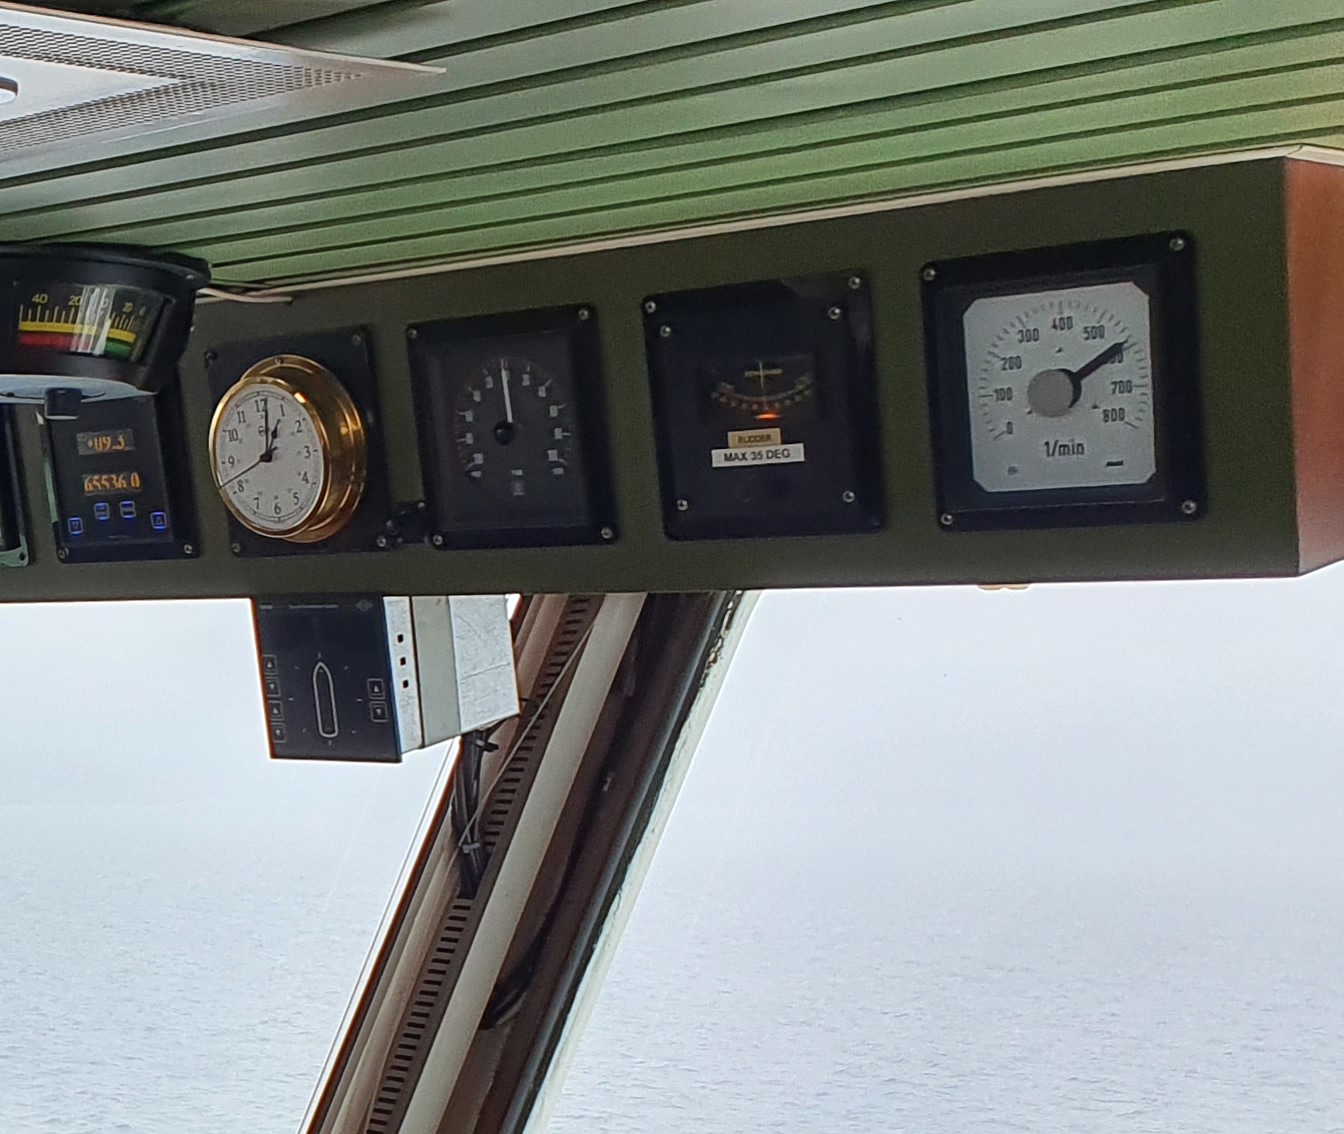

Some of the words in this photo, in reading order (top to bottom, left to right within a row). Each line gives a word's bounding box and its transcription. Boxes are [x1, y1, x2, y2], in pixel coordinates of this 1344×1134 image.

[32, 293, 49, 304] 40
[1051, 316, 1074, 331] 400
[1017, 328, 1040, 344] 300
[1083, 325, 1105, 341] 500
[1001, 356, 1023, 371] 200
[993, 387, 1014, 401] 100
[1111, 380, 1133, 395] 700
[237, 411, 247, 424] 11
[279, 404, 286, 418] 1
[1102, 408, 1126, 423] 800
[294, 420, 303, 434] 2
[1006, 421, 1014, 435] 0
[228, 428, 240, 443] 10
[304, 446, 312, 459] 3
[723, 451, 748, 462] MAX
[750, 450, 763, 461] 35
[766, 448, 791, 460] DEG
[1044, 440, 1086, 458] 1/min
[227, 455, 236, 468] 9
[301, 471, 310, 485] 4
[236, 480, 245, 493] 8
[253, 497, 261, 510] 7
[292, 492, 301, 506] 5
[274, 503, 282, 516] 6
